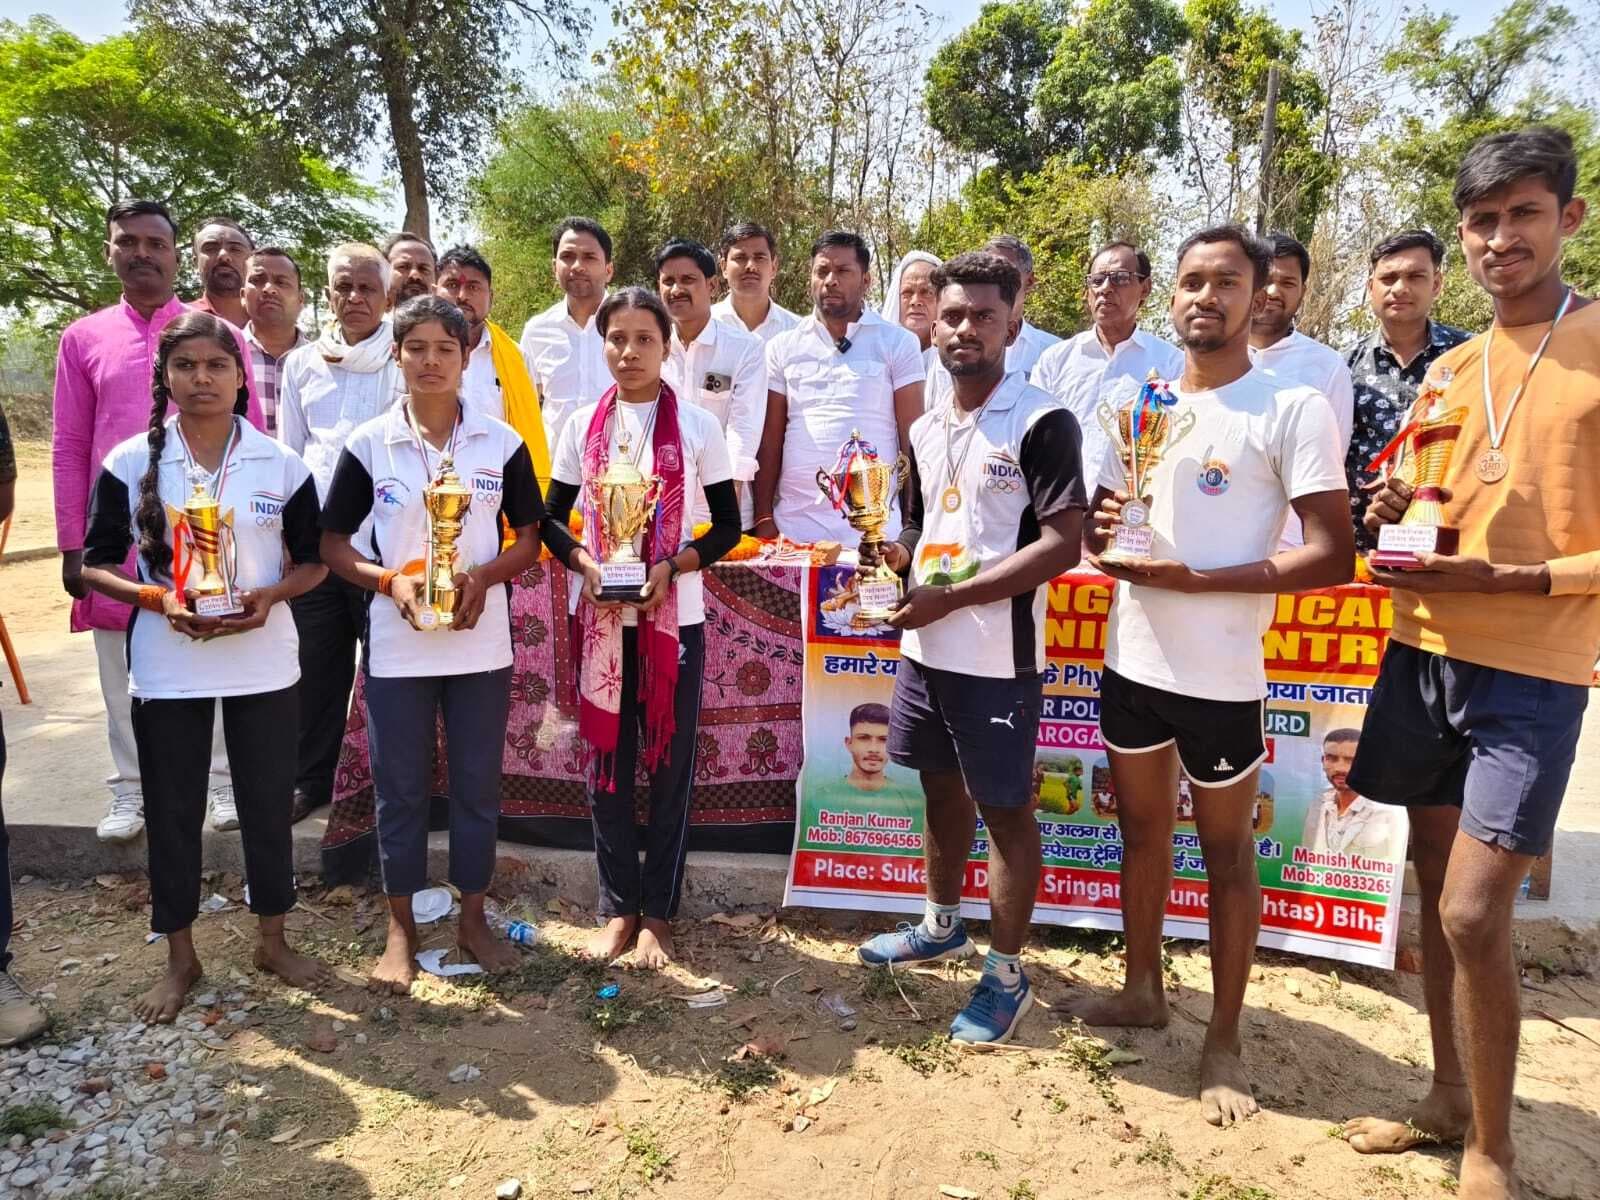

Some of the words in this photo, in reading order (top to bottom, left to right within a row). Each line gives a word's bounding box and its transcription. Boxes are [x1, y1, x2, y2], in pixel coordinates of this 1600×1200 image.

[983, 463, 1022, 478] INDIA
[1264, 630, 1389, 665] NTR
[825, 652, 880, 675] हमारे
[820, 811, 864, 828] Ranjan
[867, 814, 912, 829] Kumar
[808, 828, 841, 842] Mob:
[845, 832, 922, 848] 8676964565
[1055, 823, 1099, 839] अलग
[1294, 848, 1348, 869] Manish
[814, 858, 875, 881] Place:
[1283, 866, 1321, 885] Mob:
